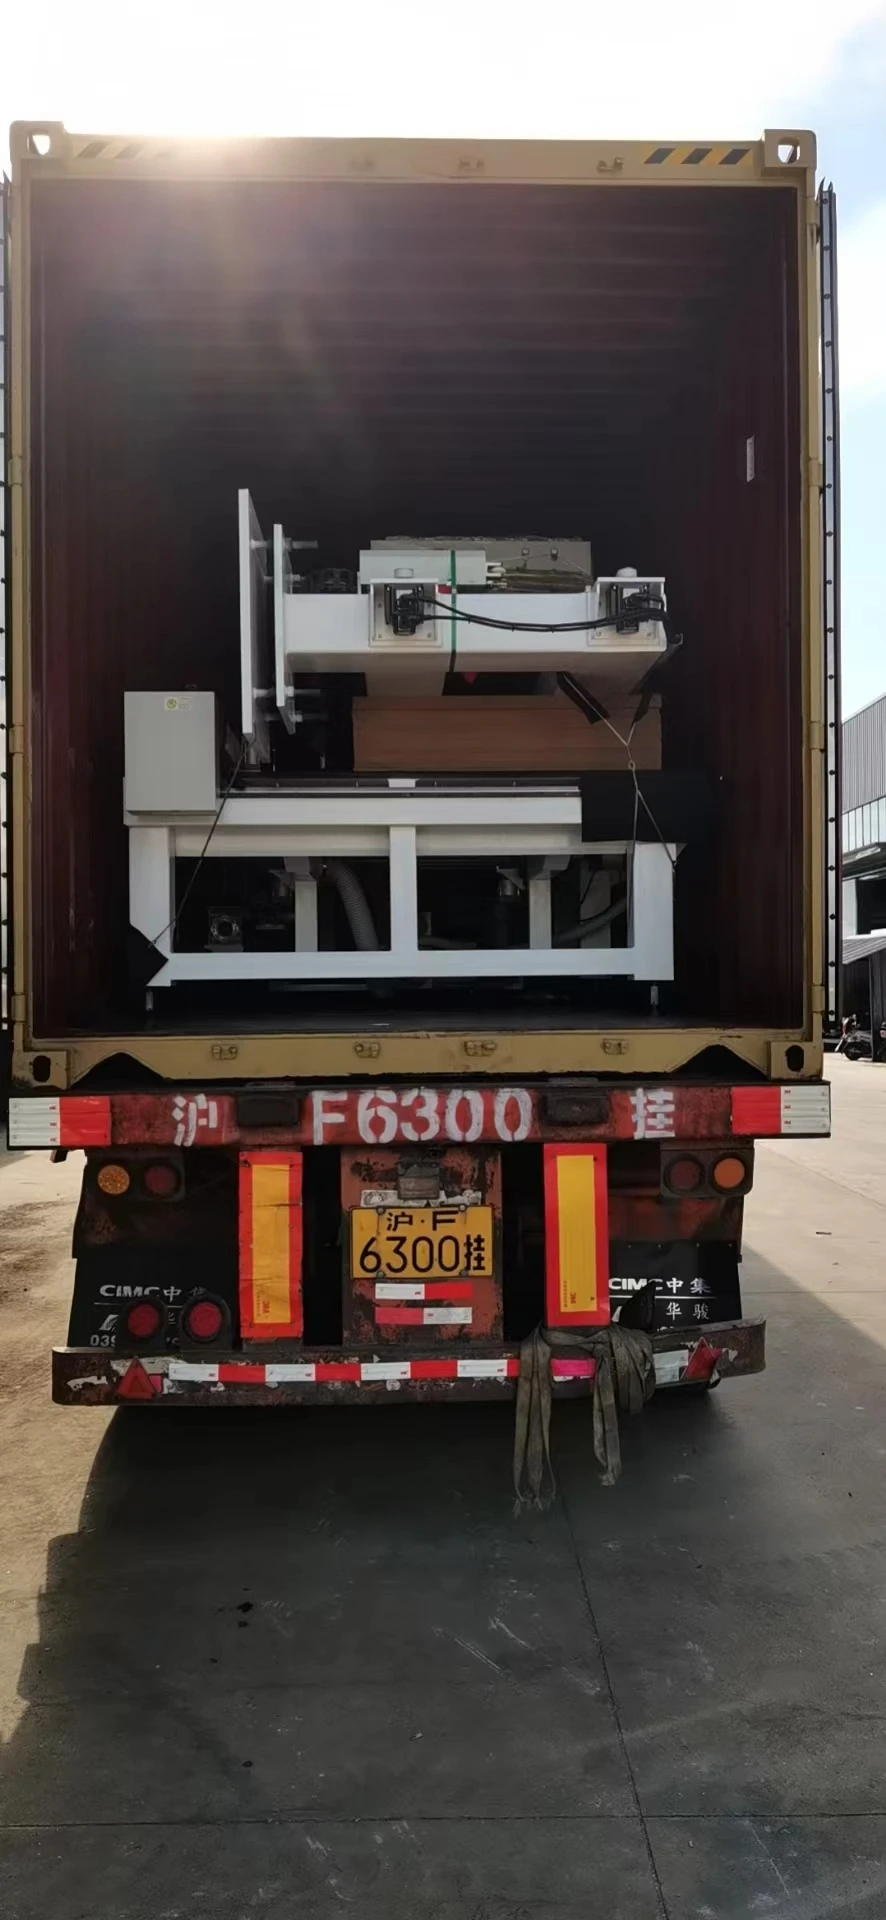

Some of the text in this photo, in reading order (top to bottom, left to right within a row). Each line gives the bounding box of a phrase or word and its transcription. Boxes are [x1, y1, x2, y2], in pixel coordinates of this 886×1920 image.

[172, 1087, 676, 1147] 沪 F6300 挂
[359, 1234, 486, 1273] 6300挂
[665, 1301, 710, 1321] 华骏
